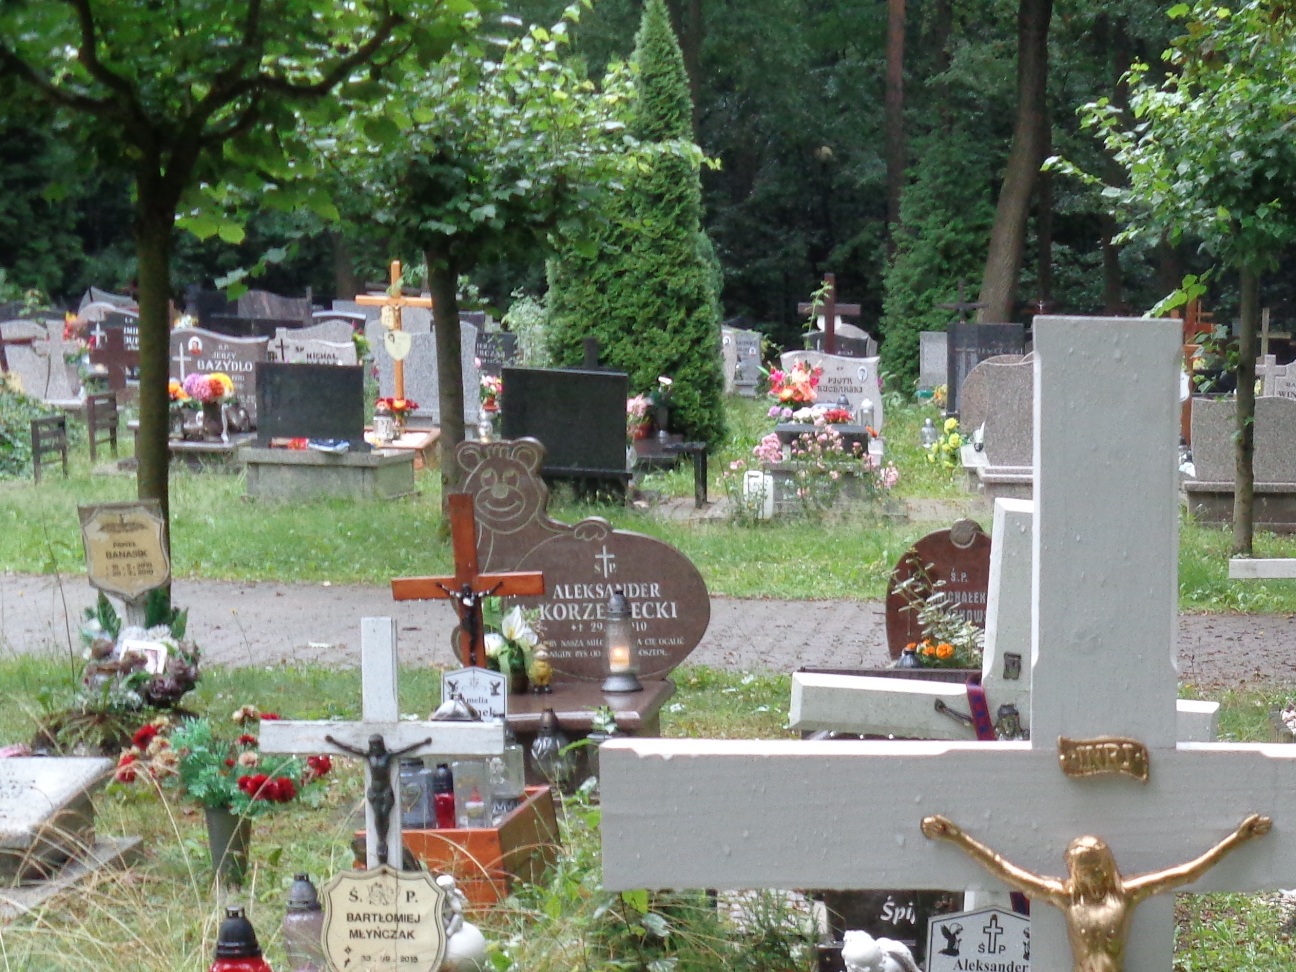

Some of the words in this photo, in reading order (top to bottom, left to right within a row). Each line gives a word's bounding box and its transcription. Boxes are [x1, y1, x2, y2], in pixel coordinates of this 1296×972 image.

[553, 582, 661, 600] ALEKSANDER
[538, 601, 678, 621] KORZEECKI
[346, 912, 421, 923] BARTŁOMIEJ
[349, 925, 416, 940] MŁYŃCZAK
